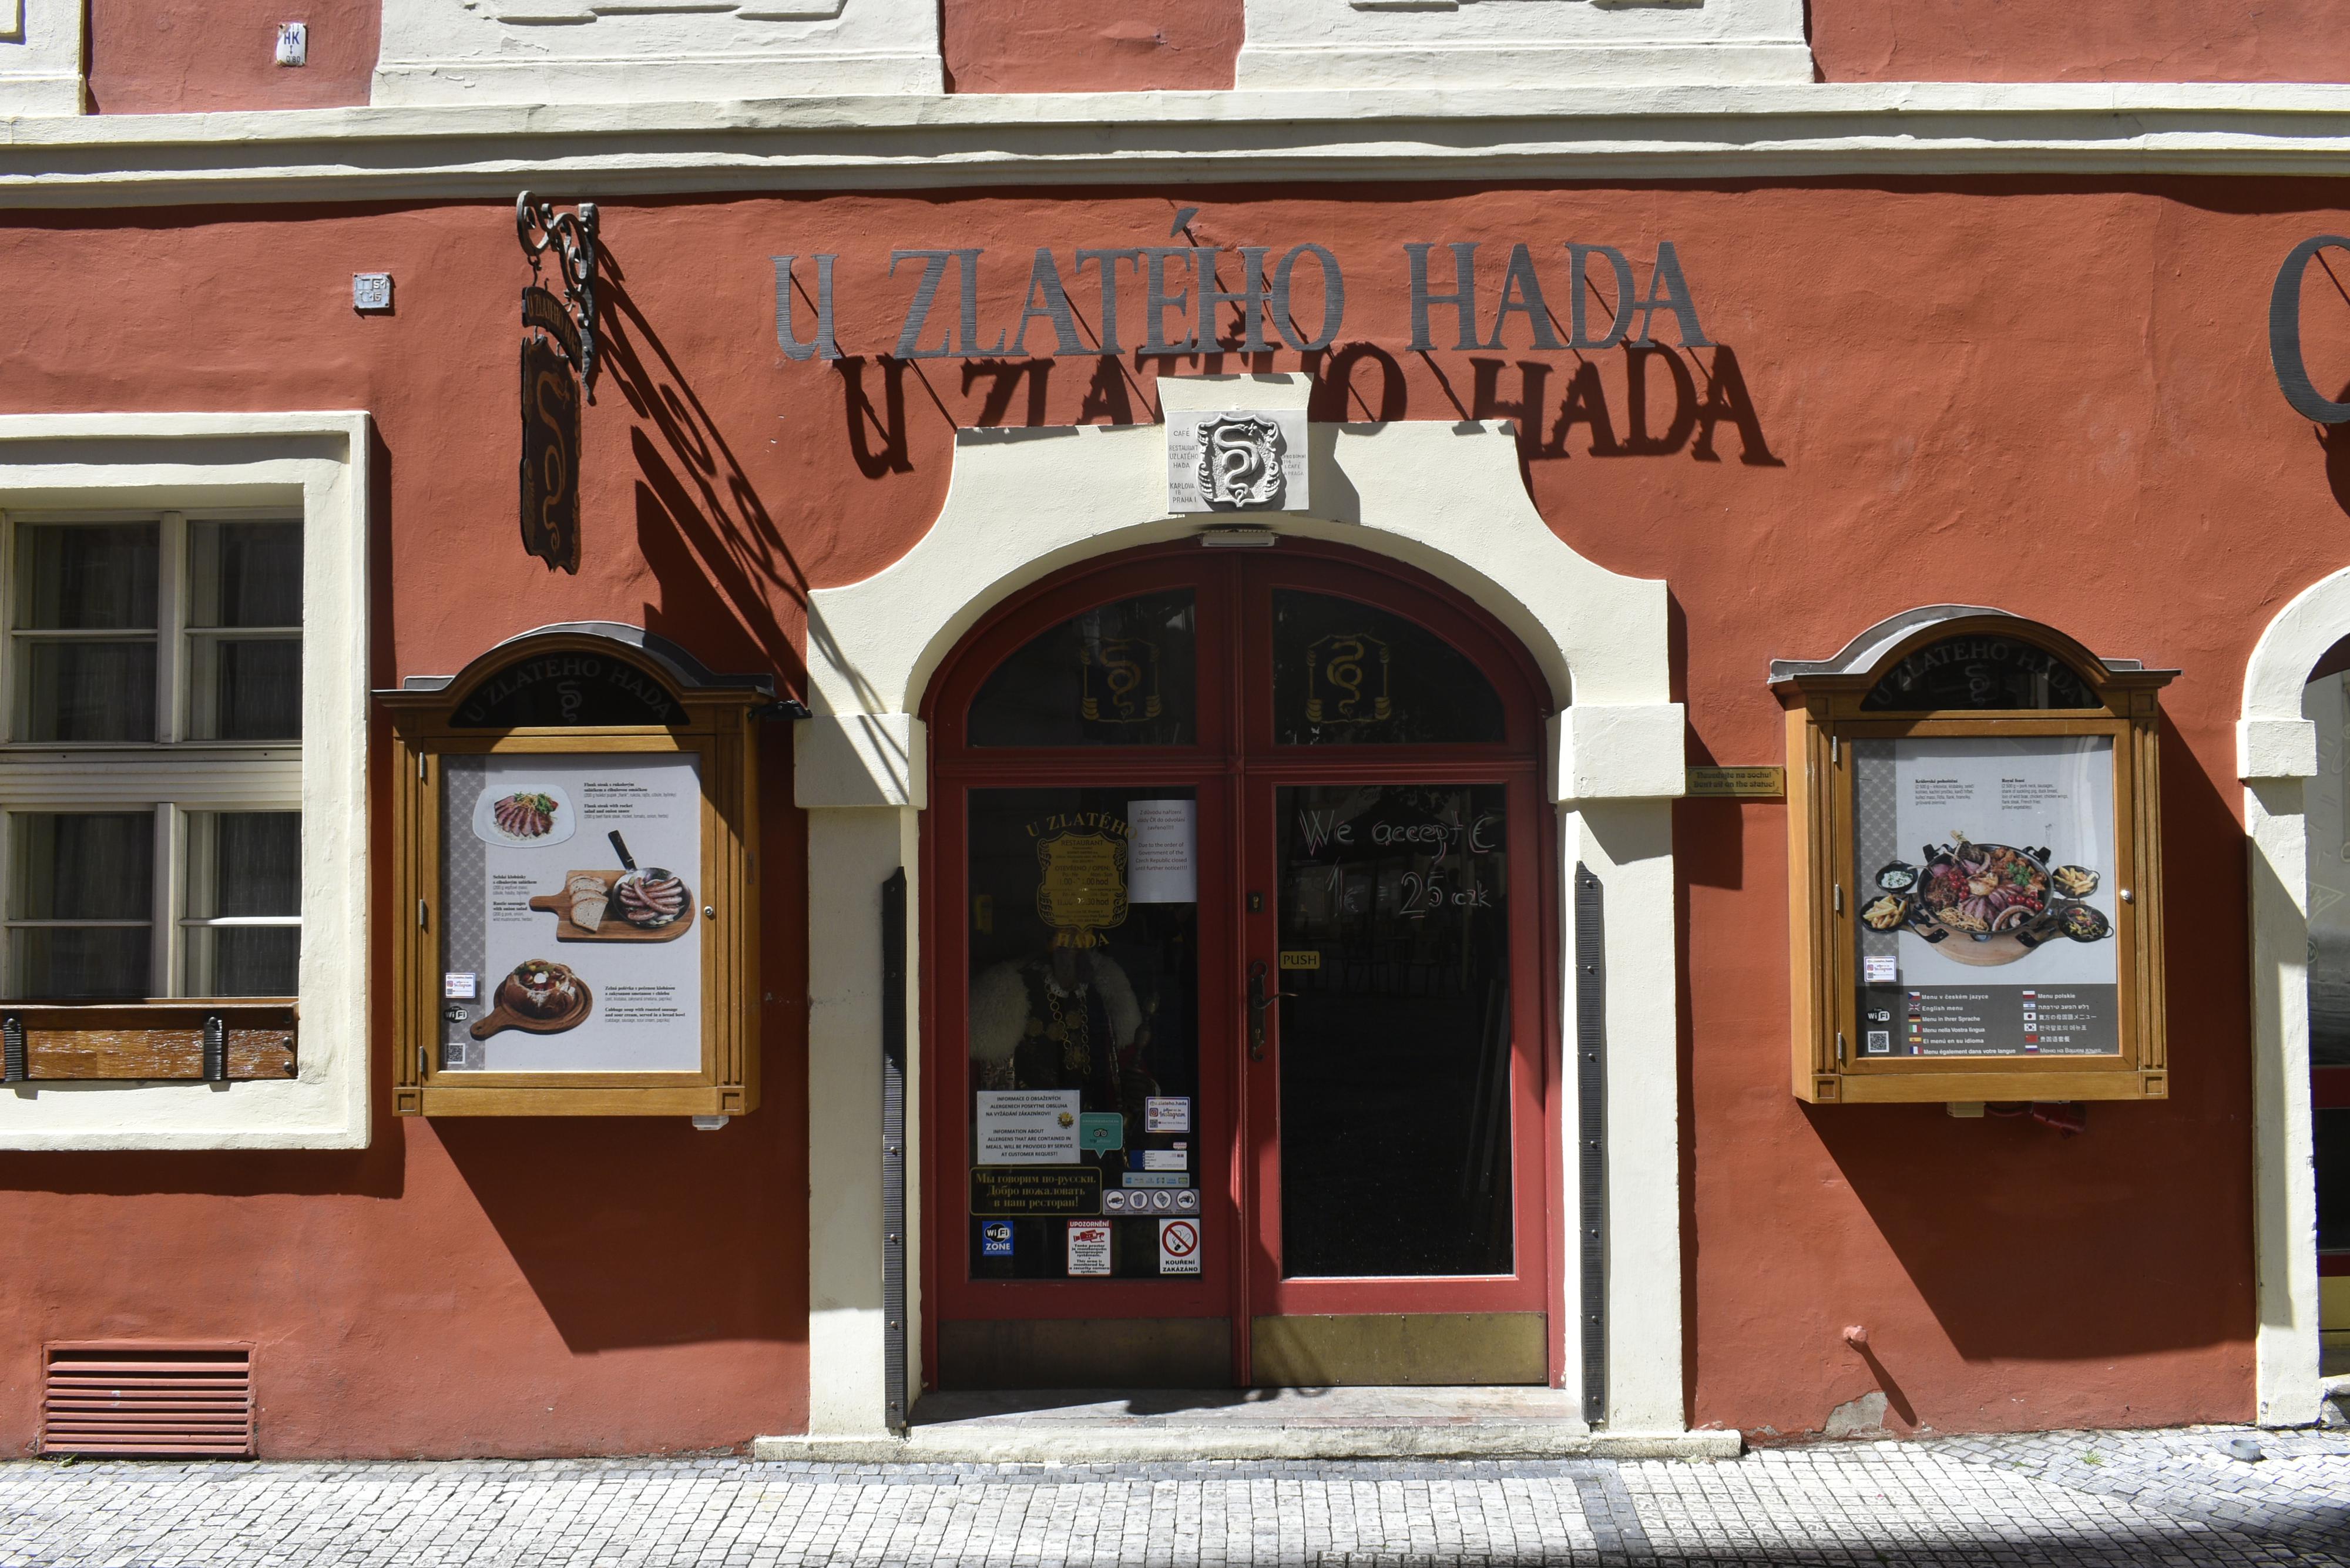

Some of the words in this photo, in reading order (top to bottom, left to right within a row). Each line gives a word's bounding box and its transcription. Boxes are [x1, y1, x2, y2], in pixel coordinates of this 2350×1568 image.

[284, 32, 300, 45] HK
[769, 254, 845, 361] U
[888, 207, 1345, 360] ZLATÉHO
[1403, 241, 1720, 351] HADA
[1173, 428, 1190, 437] CAFÉ
[1890, 638, 2009, 688] ZLATÉHO
[2016, 649, 2080, 705] HADA
[483, 655, 601, 706] ZLATÉHO
[607, 664, 671, 721] HADA
[1026, 821, 1040, 837] U
[1046, 812, 1138, 840] ZLATÉHO
[1298, 808, 1355, 857] We
[1372, 810, 1465, 865] accept
[1399, 871, 1445, 920] 25
[1056, 932, 1110, 948] HADA
[1284, 955, 1317, 965] PUSH
[1159, 1111, 1186, 1119] Instagram
[976, 1173, 995, 1184] Мы
[997, 1176, 1039, 1186] говорим
[1042, 1176, 1097, 1186] по-русски.
[1022, 1187, 1086, 1196] пожаловать
[1029, 1196, 1079, 1209] ресторан!
[986, 1229, 1008, 1237] WiFi
